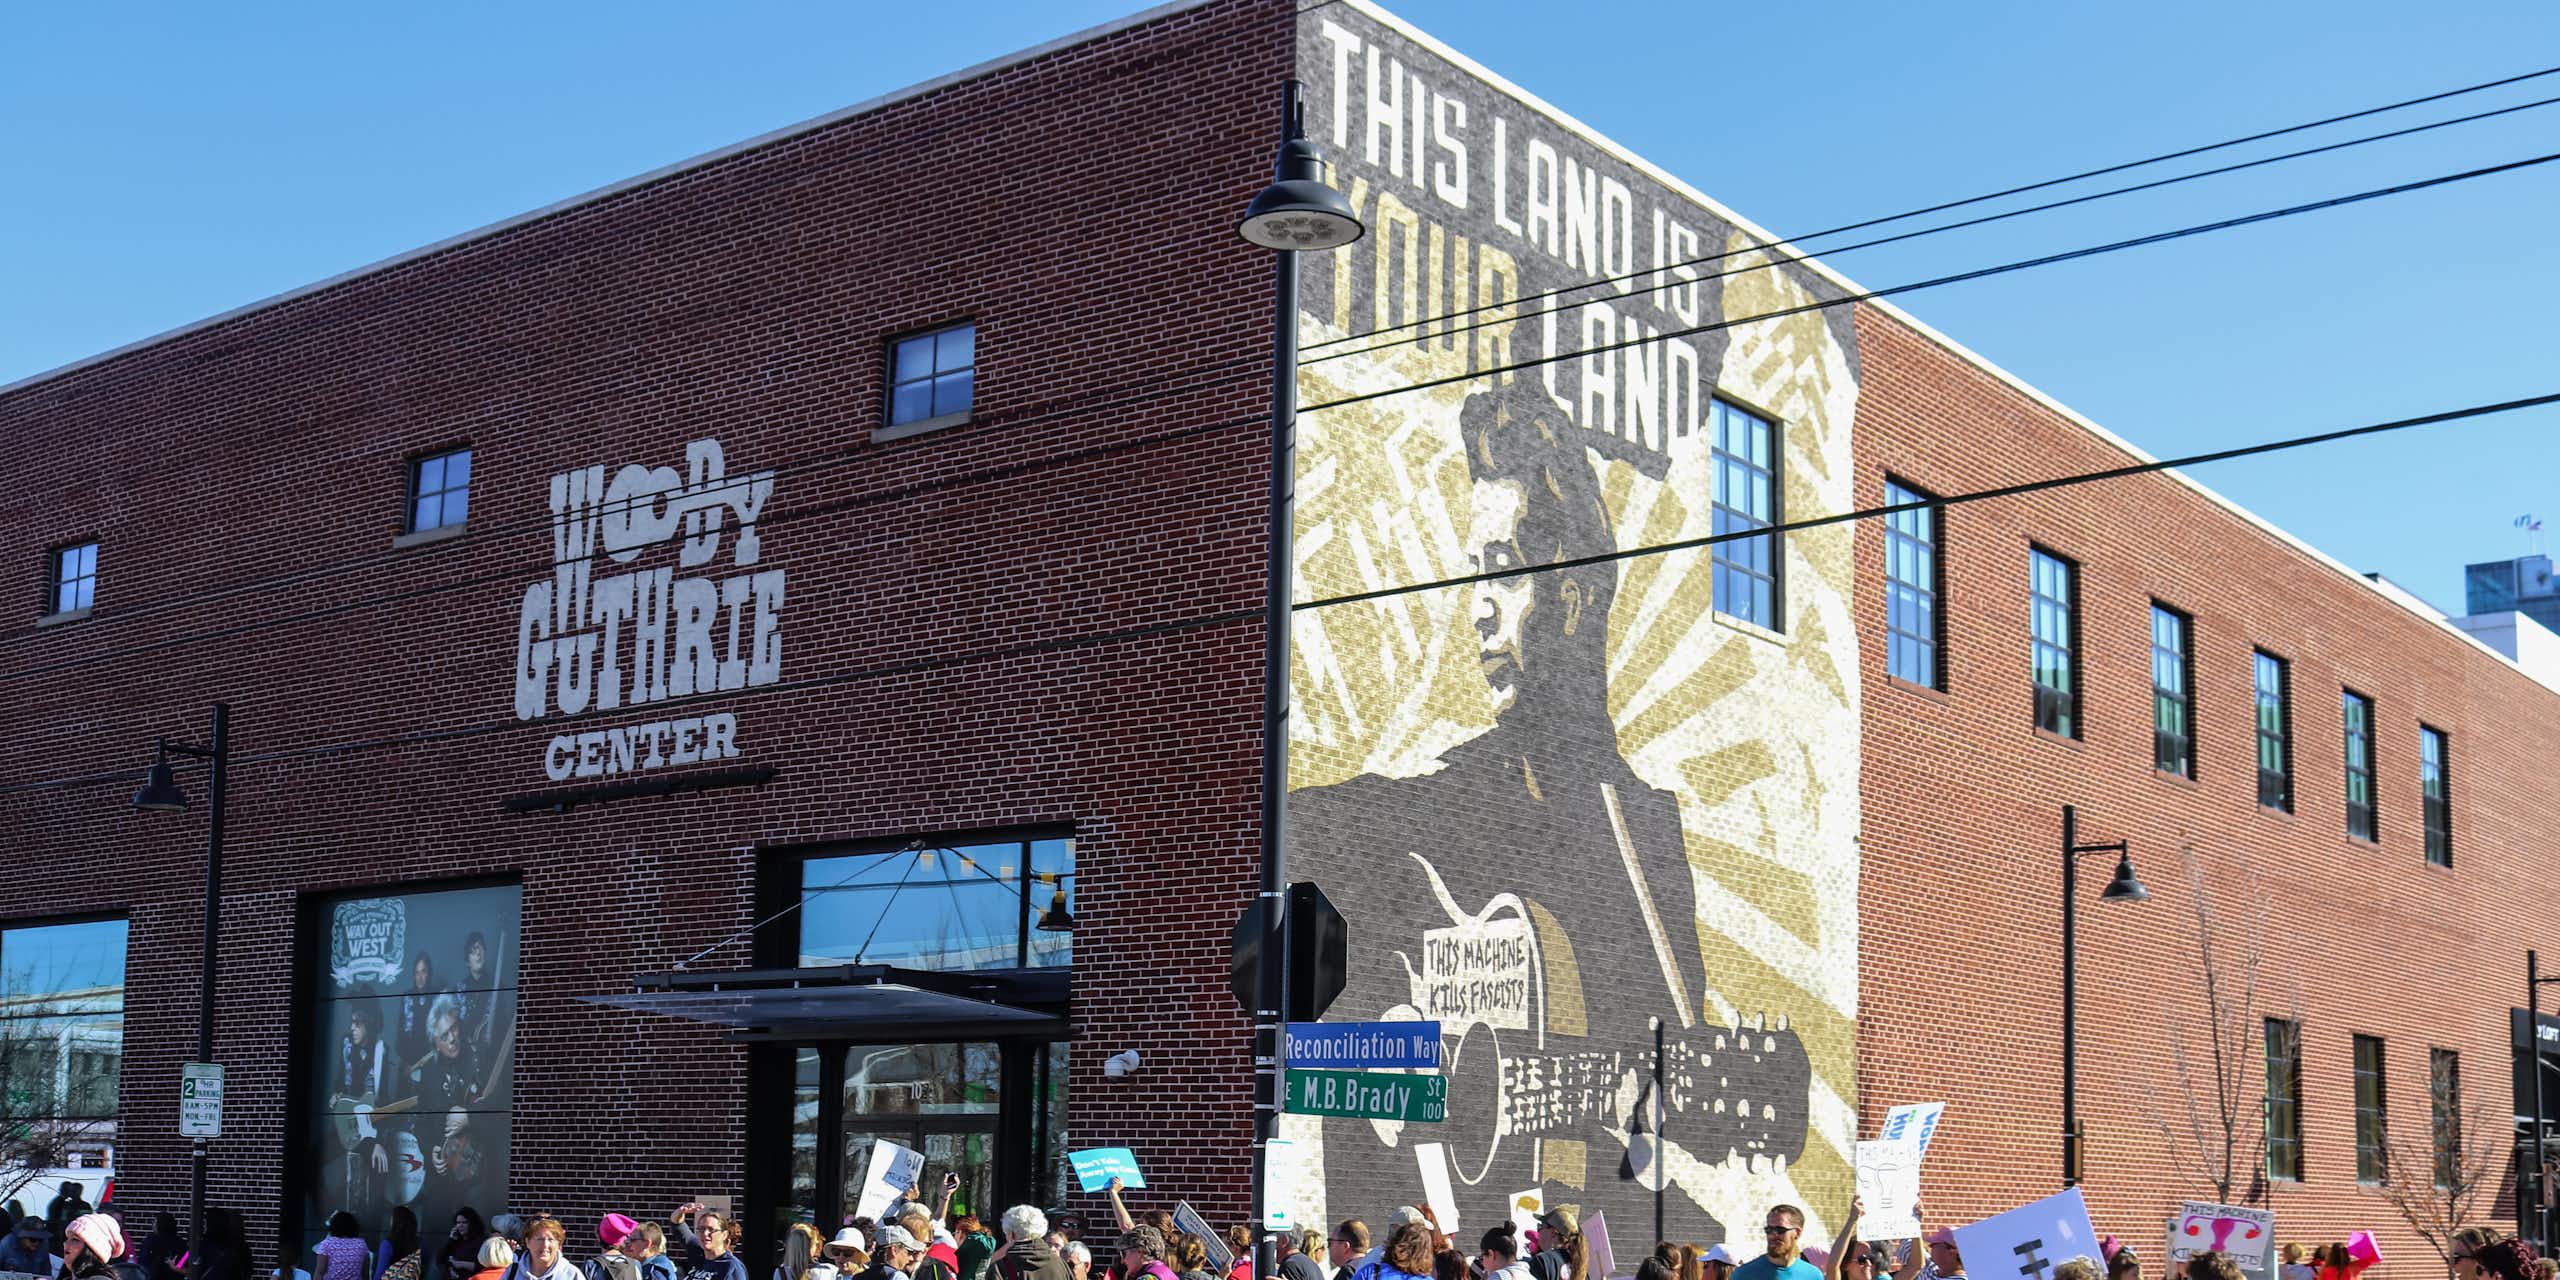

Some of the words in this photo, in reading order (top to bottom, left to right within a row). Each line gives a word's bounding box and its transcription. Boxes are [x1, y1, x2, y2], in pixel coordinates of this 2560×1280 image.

[1322, 19, 1468, 210] THIS
[1493, 116, 1633, 293] LAND
[1652, 207, 1699, 329] IS
[1324, 161, 1517, 387] YOUR
[1542, 287, 1699, 454] LAND
[550, 438, 775, 633] WOODY
[515, 566, 785, 721] GUTHRIE
[545, 712, 740, 781] CENTER
[345, 925, 368, 939] WAY
[369, 922, 392, 937] OUT
[348, 937, 388, 957] WEST
[1426, 937, 1459, 977] THIS
[1464, 935, 1525, 974] MACHINE
[1430, 980, 1467, 1018] KILLS
[1470, 978, 1524, 1014] FASCISTS
[1286, 1032, 1405, 1060] Reconciliation
[1413, 1035, 1438, 1064] Way
[184, 1081, 194, 1096] 2
[1286, 1081, 1292, 1100] E
[1345, 1078, 1411, 1120] Brady
[1426, 1077, 1440, 1097] St
[1423, 1102, 1442, 1119] 100
[2183, 1204, 2214, 1216] THIS
